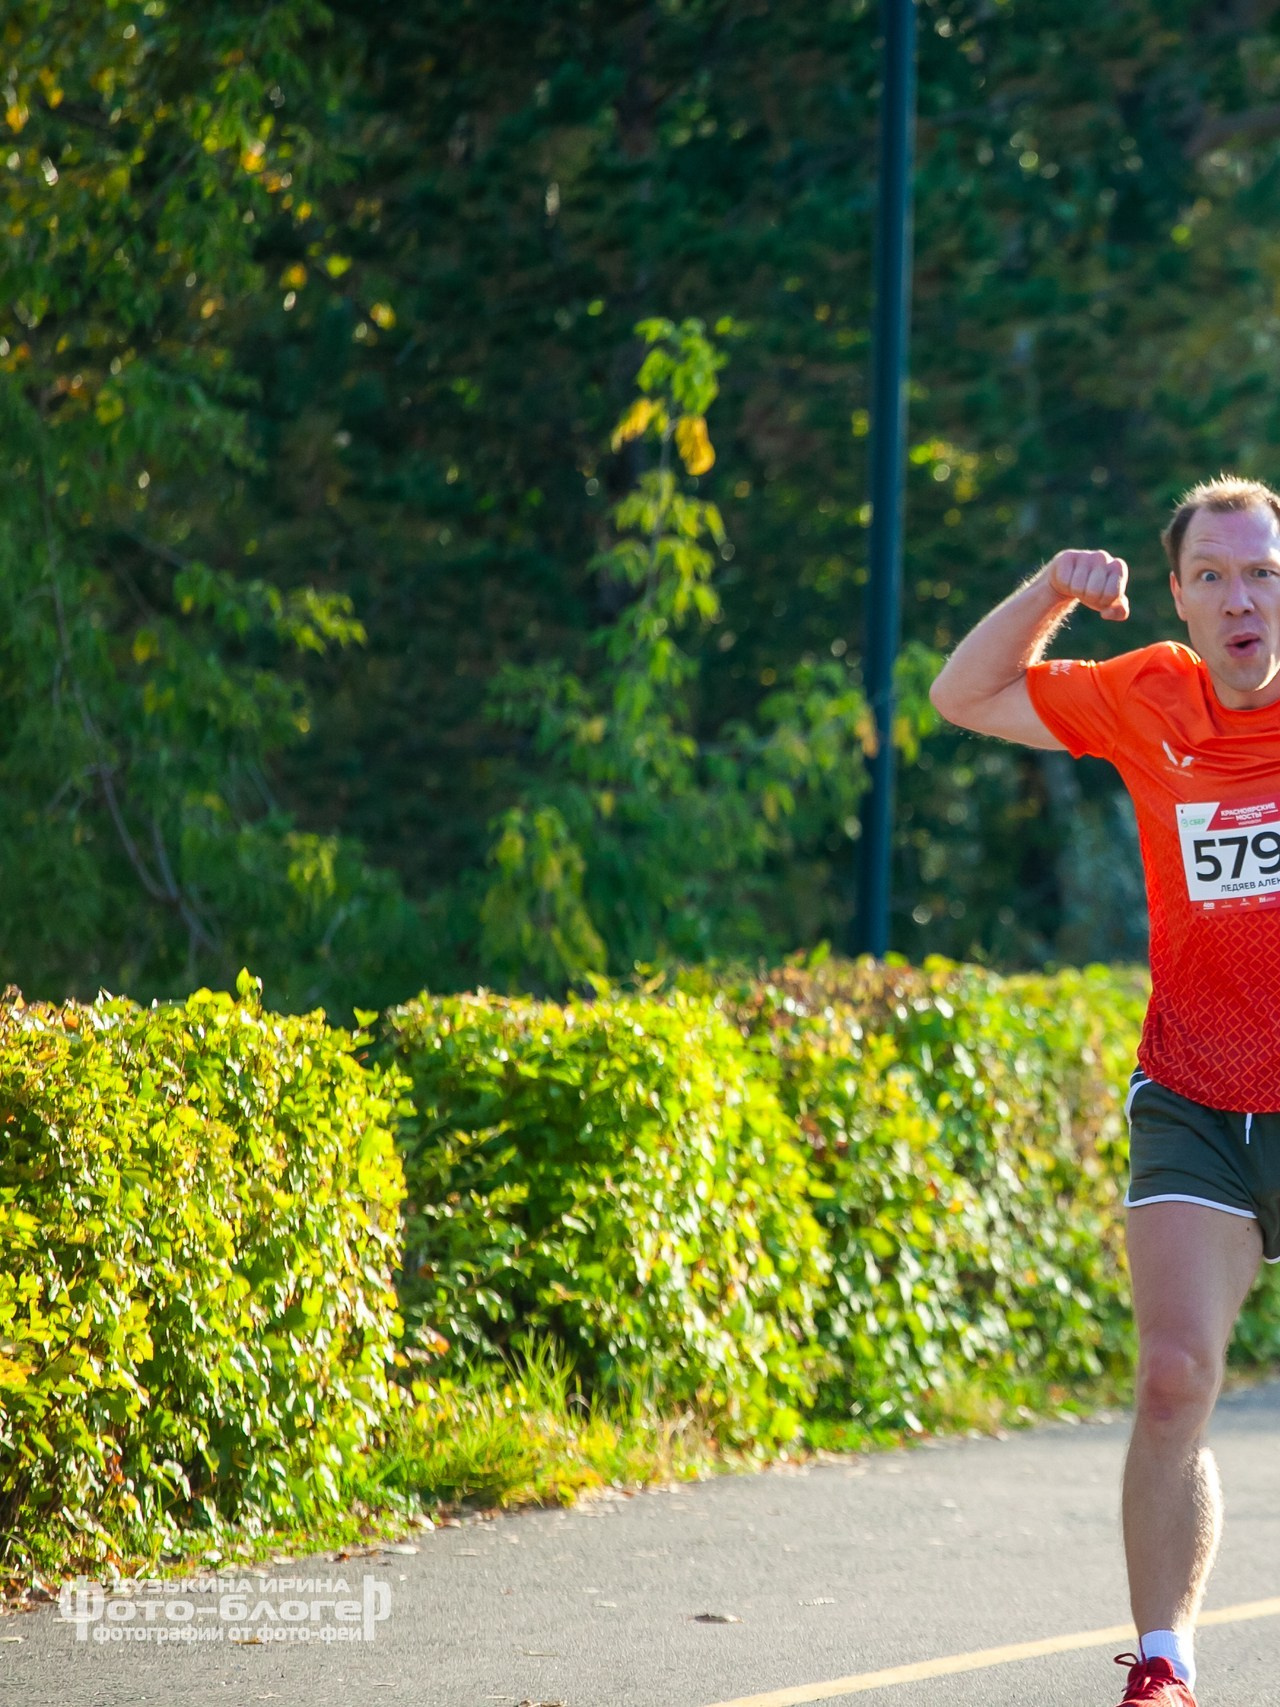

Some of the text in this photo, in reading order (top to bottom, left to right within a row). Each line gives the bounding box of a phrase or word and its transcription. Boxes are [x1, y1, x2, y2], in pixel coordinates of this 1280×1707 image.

[1220, 802, 1276, 817] КРАСНОЯРСКИЕ
[1235, 811, 1263, 822] МОСТЫ
[1220, 880, 1256, 893] ЛЕДЯЕВ
